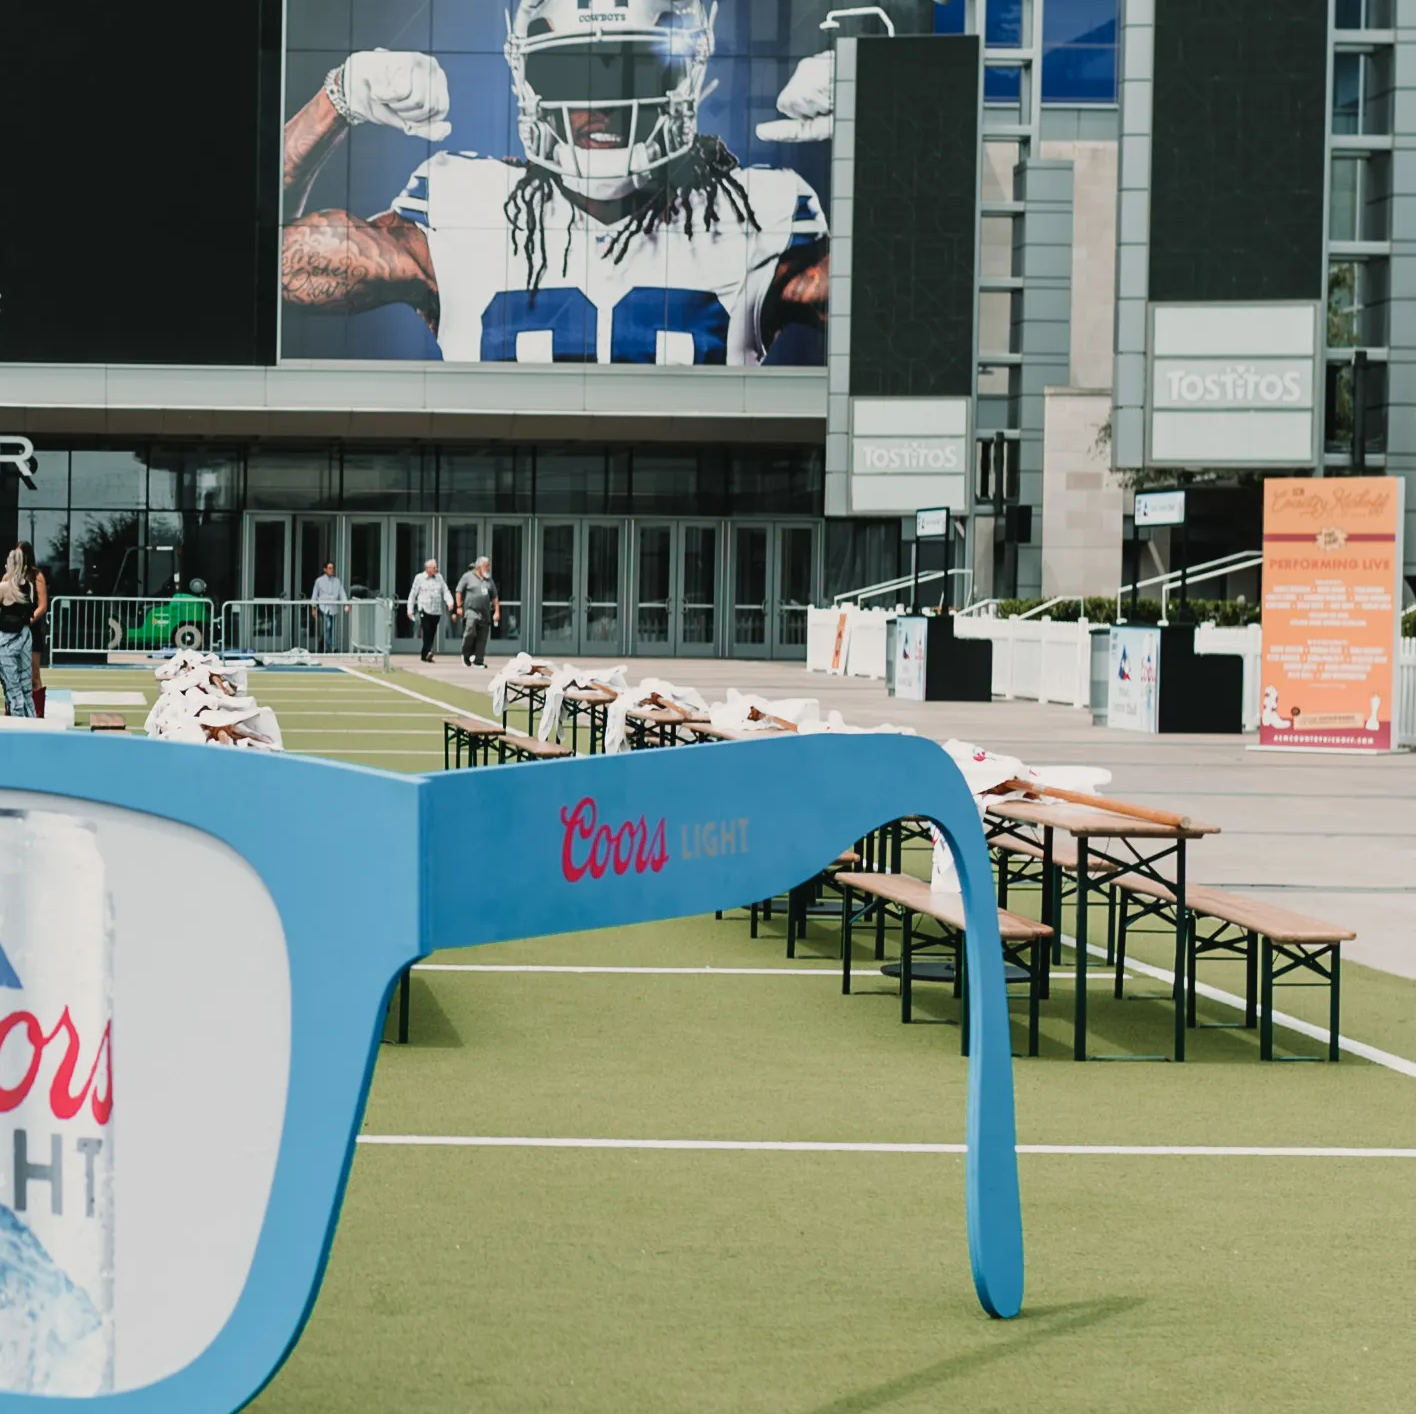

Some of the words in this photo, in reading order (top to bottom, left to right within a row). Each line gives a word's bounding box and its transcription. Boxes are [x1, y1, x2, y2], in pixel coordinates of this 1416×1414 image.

[578, 13, 626, 23] COWBOYS
[1269, 559, 1359, 570] PERFORMING
[1363, 559, 1390, 570] LIVE
[559, 796, 670, 884] Coors
[682, 817, 750, 861] LIGHT
